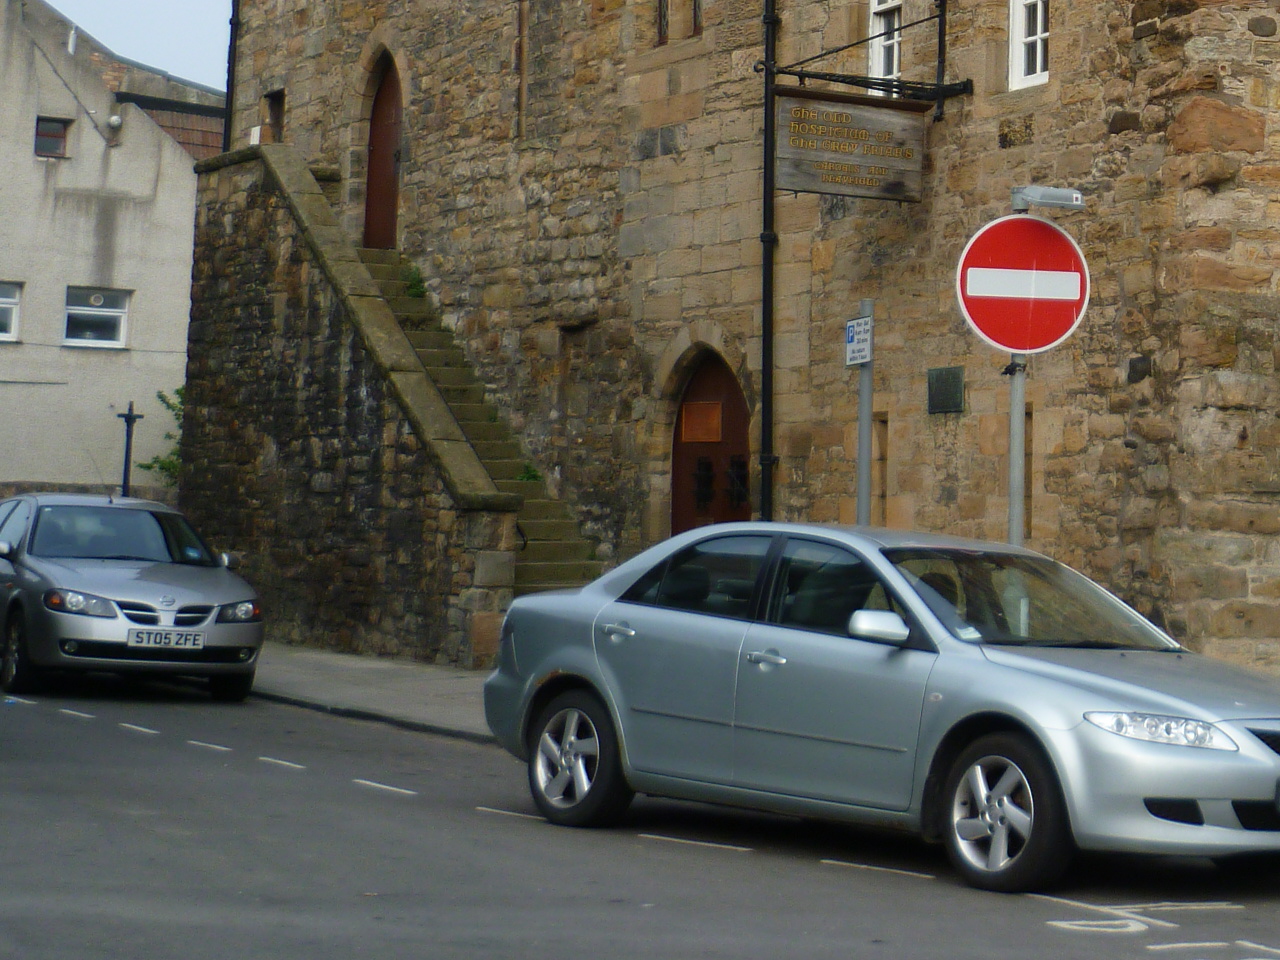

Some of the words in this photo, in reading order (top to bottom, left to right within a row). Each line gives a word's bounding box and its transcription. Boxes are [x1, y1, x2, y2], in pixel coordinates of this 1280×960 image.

[822, 112, 852, 124] OLD
[789, 121, 869, 141] HOSPITIUM
[875, 130, 894, 142] OF
[821, 139, 859, 153] GREY
[863, 144, 913, 159] FRIARS
[849, 327, 854, 341] P
[136, 631, 172, 645] ST05
[175, 633, 201, 646] ZFE
